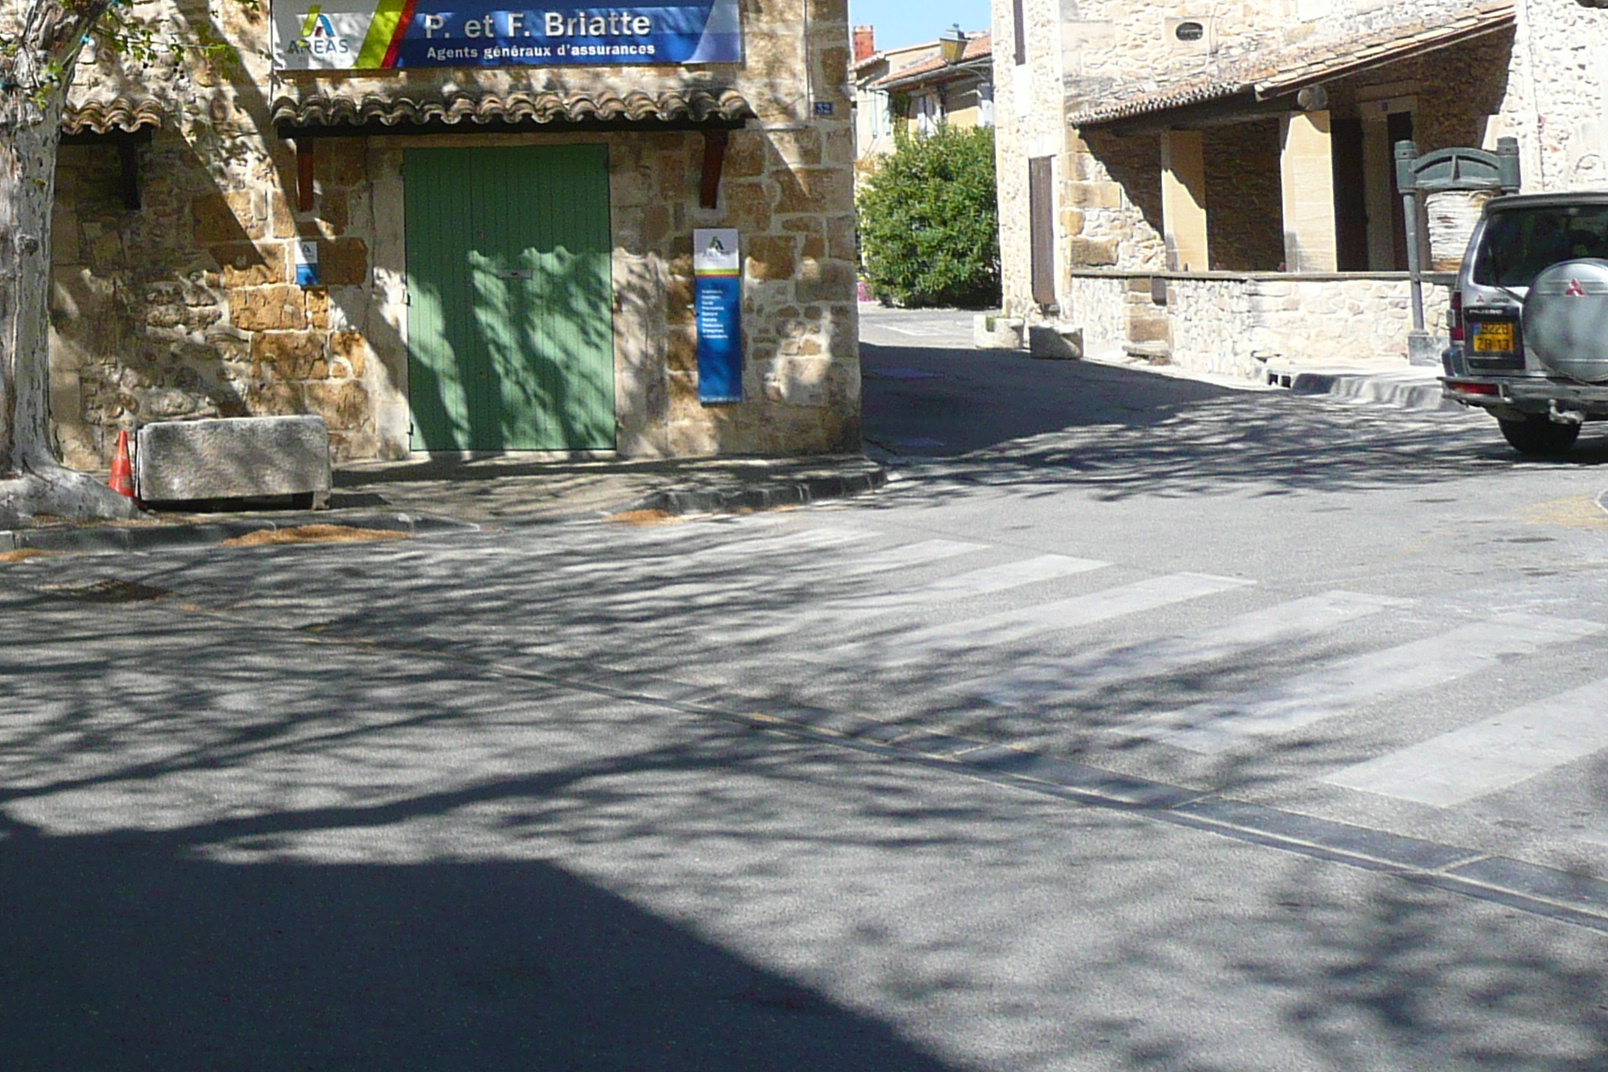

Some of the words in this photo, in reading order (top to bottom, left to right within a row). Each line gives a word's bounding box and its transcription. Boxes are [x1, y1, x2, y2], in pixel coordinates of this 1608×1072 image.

[425, 13, 451, 39] P.
[464, 14, 494, 38] et
[507, 12, 531, 37] F.
[544, 11, 652, 37] Briatte
[426, 46, 479, 61] Agents
[483, 44, 552, 60] généraux
[556, 43, 657, 57] d'assurances
